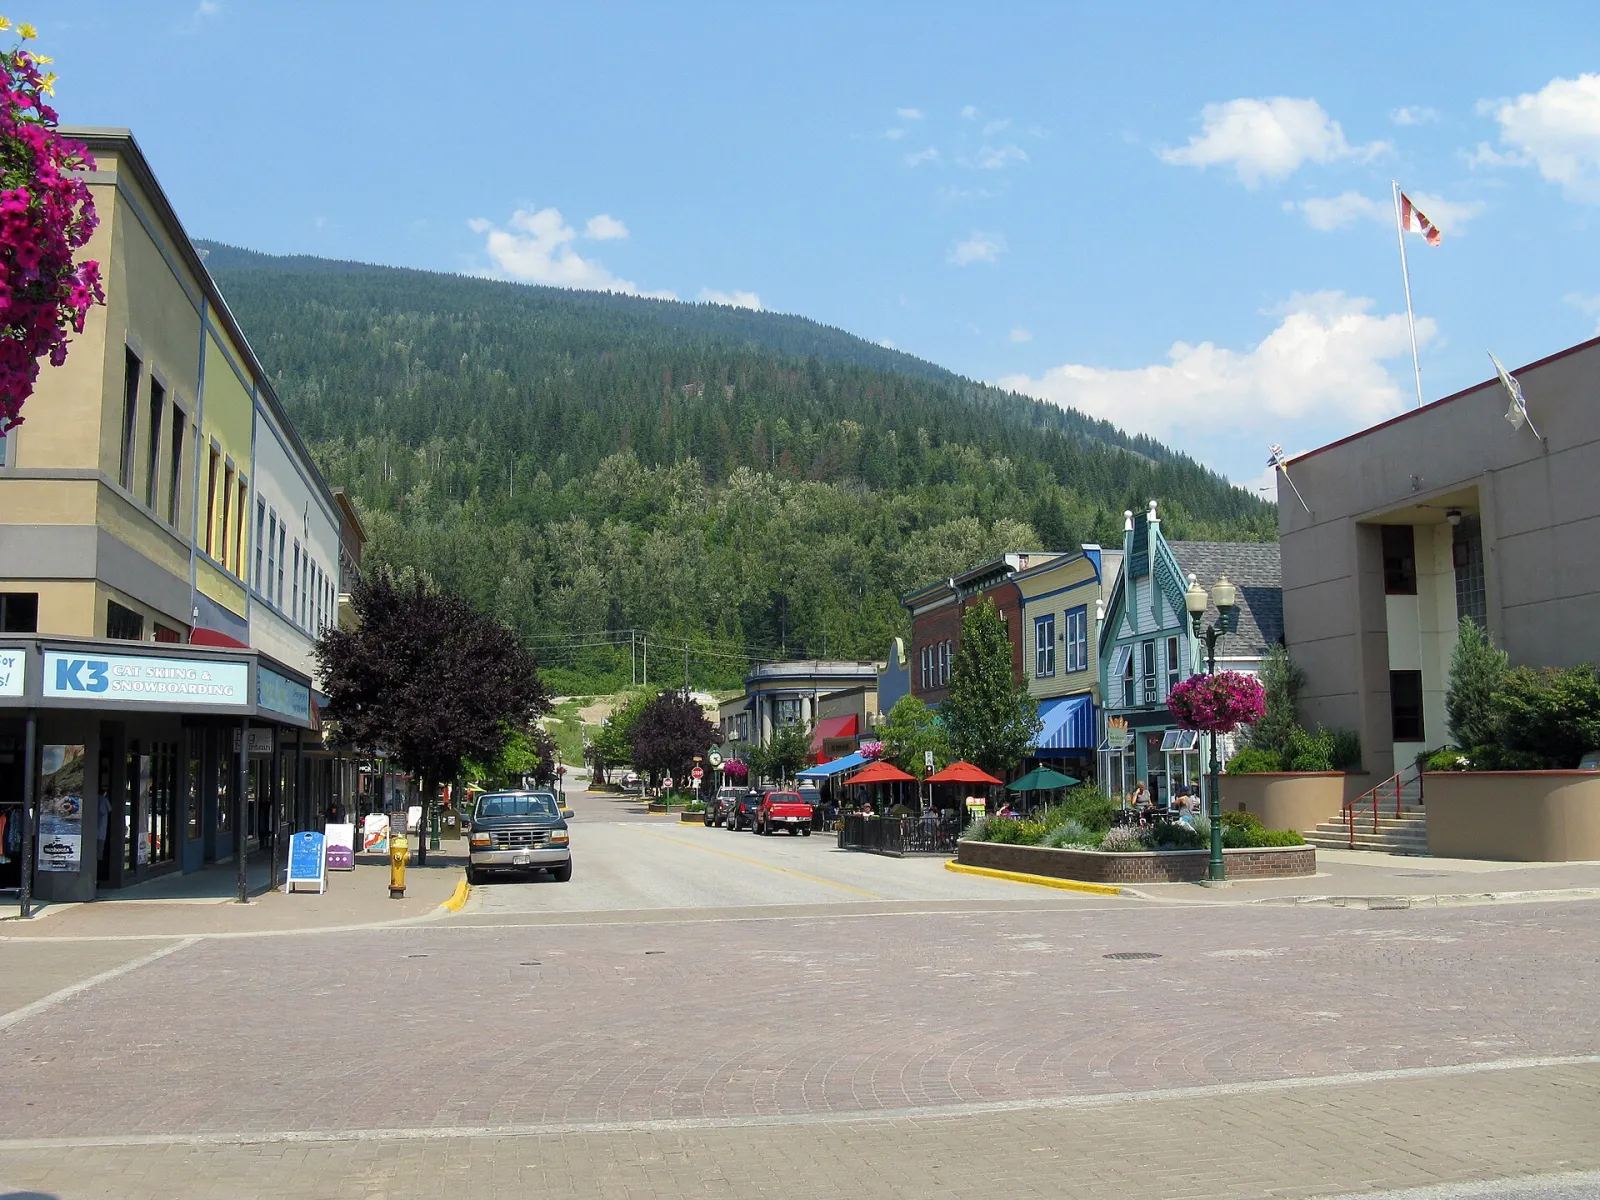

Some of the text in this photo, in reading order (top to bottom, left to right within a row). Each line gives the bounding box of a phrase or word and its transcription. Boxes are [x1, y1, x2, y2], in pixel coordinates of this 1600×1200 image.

[56, 659, 109, 693] K3
[112, 664, 212, 681] CAT SKIING &
[112, 680, 234, 696] SNOWBOARDING
